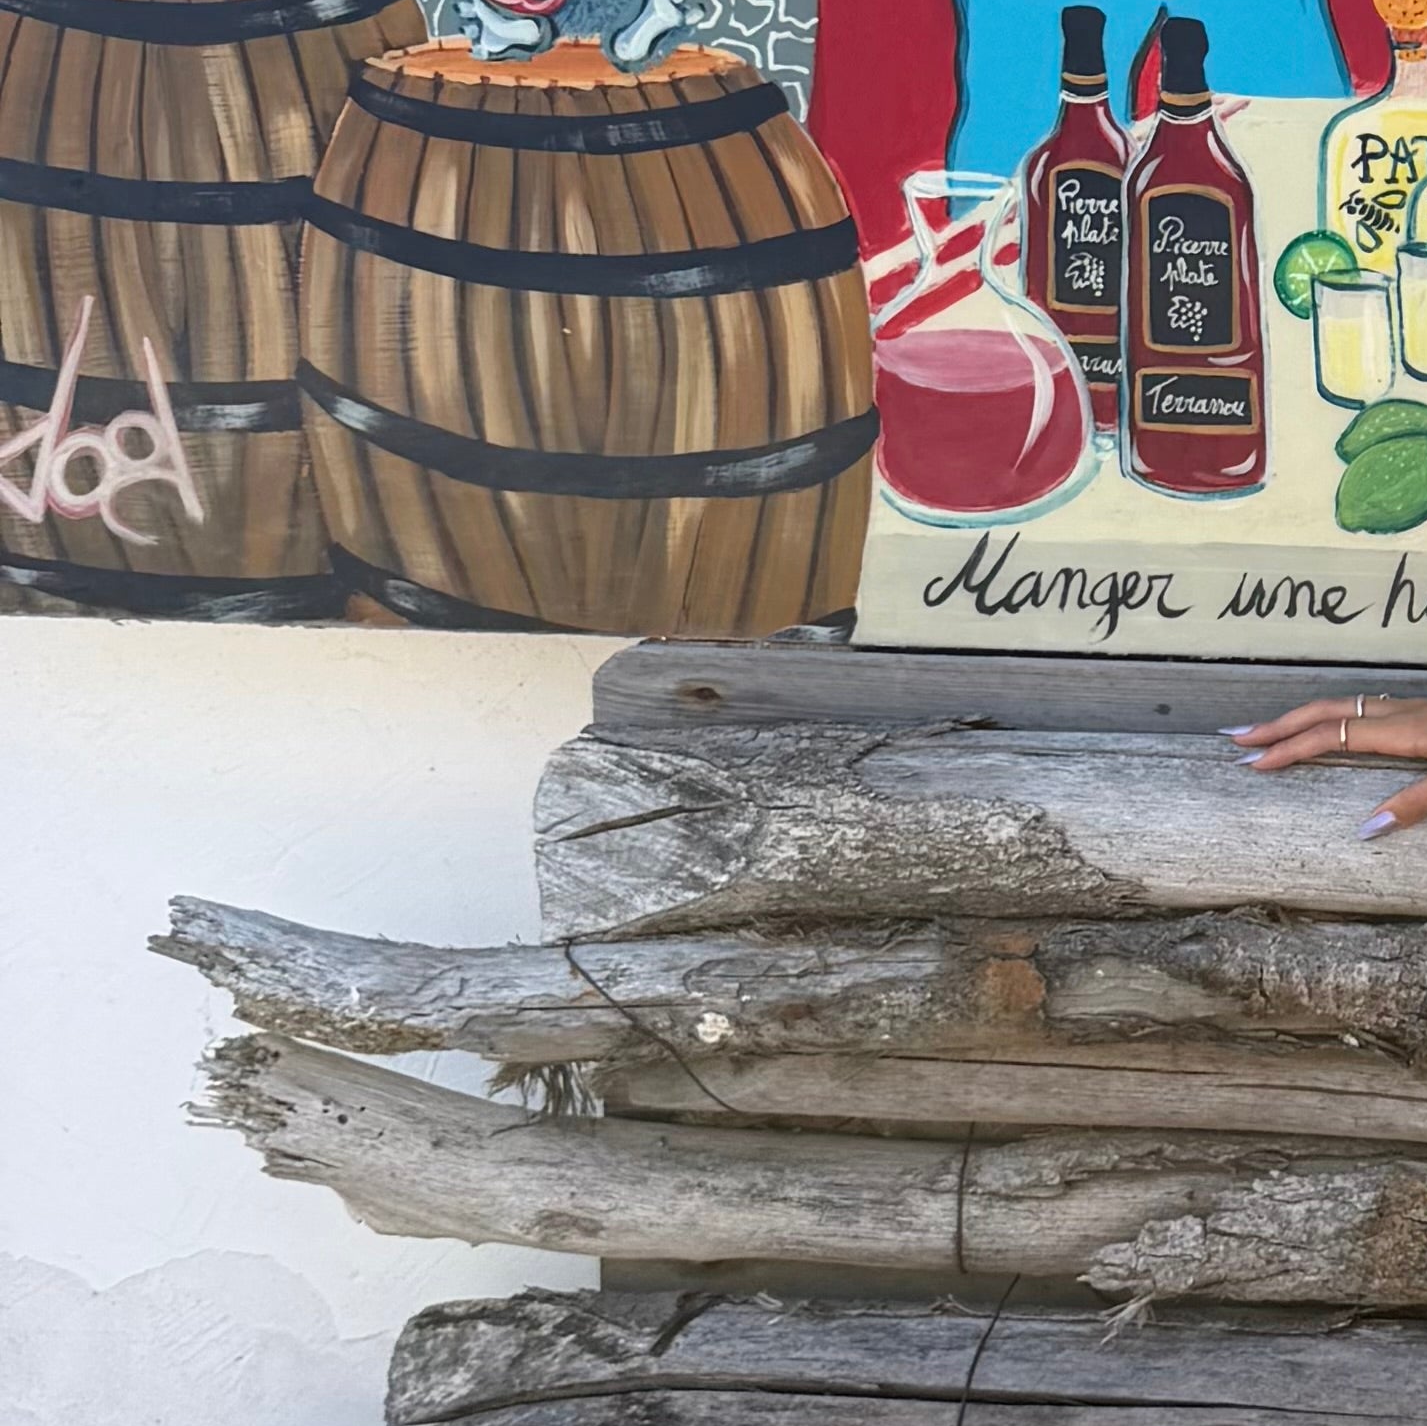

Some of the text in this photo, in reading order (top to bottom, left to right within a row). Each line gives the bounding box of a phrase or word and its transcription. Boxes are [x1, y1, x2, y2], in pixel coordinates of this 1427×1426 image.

[1057, 178, 1120, 215] Pierre
[1061, 214, 1121, 249] plate
[1159, 256, 1220, 293] plate
[923, 530, 1195, 645] Manger
[1216, 570, 1374, 625] une
